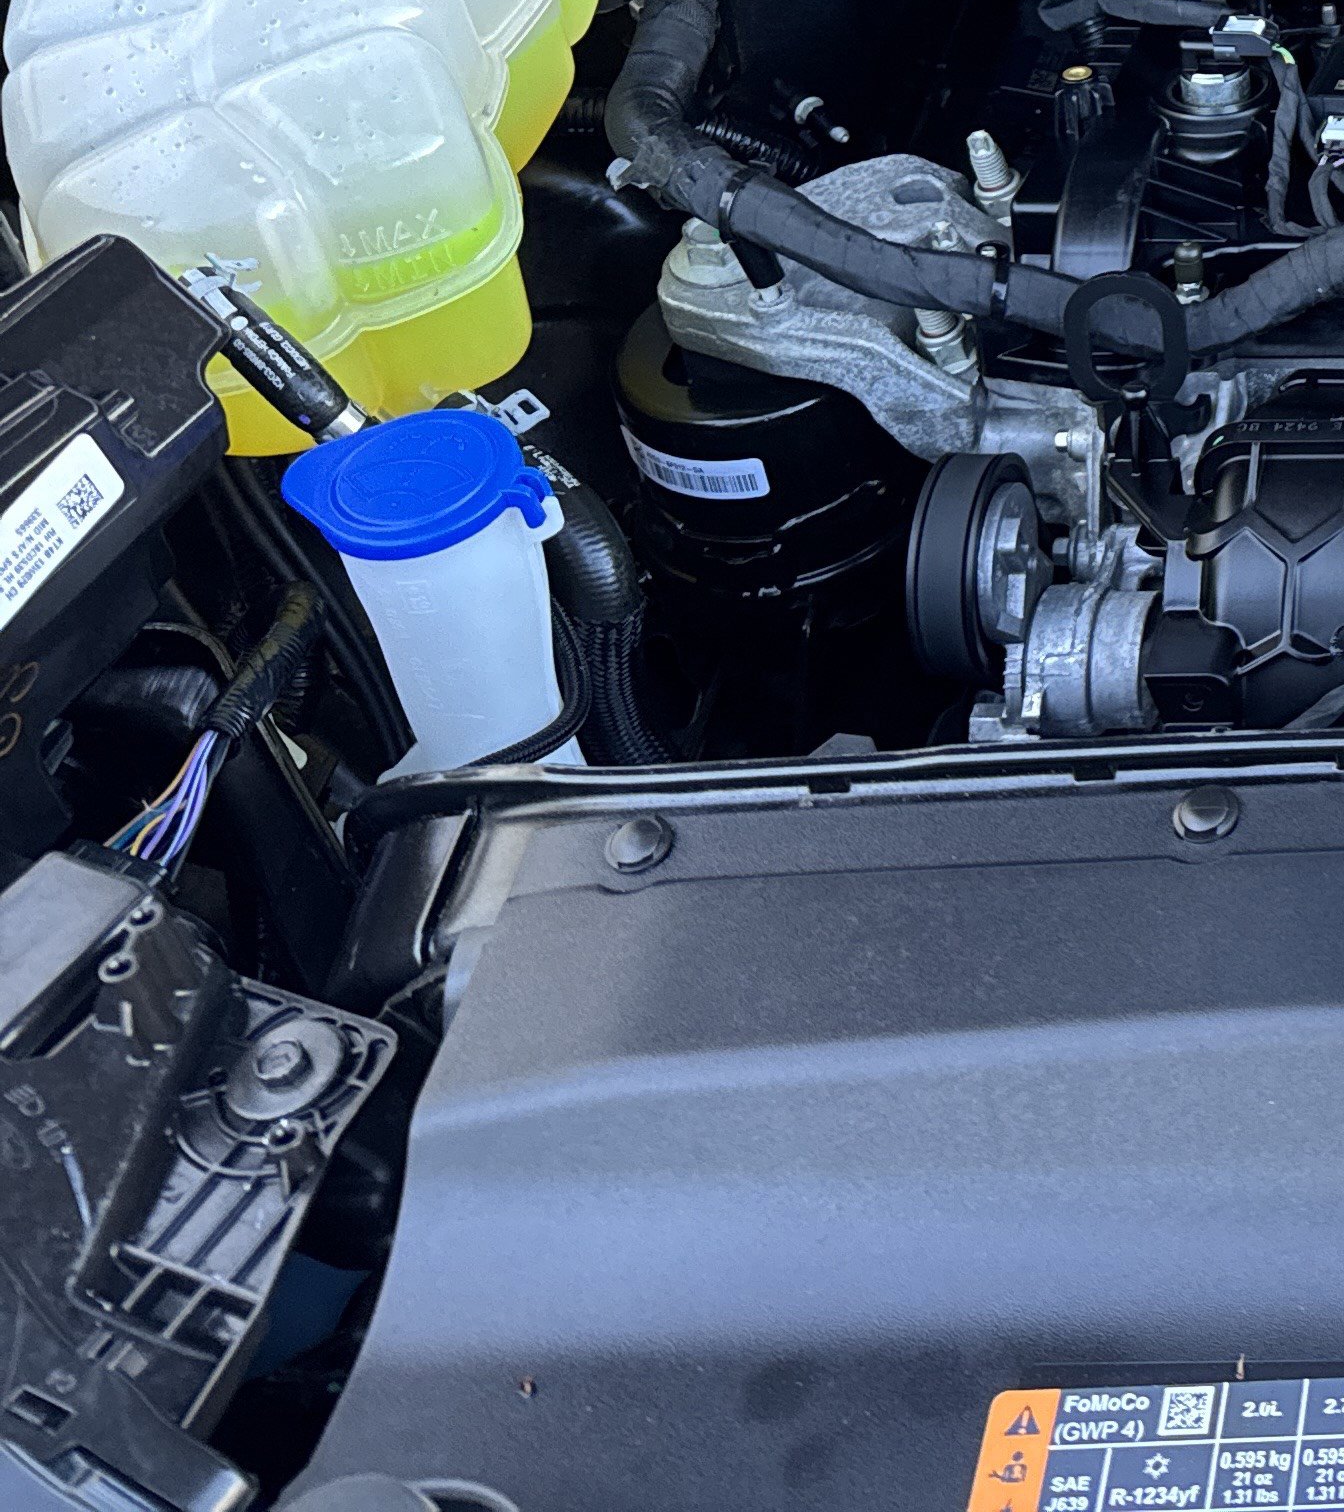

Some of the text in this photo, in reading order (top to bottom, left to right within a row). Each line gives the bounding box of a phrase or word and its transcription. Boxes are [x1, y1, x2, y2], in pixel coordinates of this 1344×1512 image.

[358, 207, 447, 257] MAX
[1063, 1393, 1151, 1413] FoMoCo
[1054, 1419, 1145, 1445] (GWP 4)
[1220, 1450, 1291, 1472] 0.595 kg
[1050, 1475, 1092, 1492] SAE
[1233, 1472, 1273, 1486] 21 oz
[1315, 1469, 1335, 1483] 21
[1108, 1485, 1200, 1507] R-1234yf
[1223, 1488, 1279, 1505] 1.31 lbs
[1306, 1486, 1335, 1502] 1.31
[1045, 1495, 1089, 1512] J639
